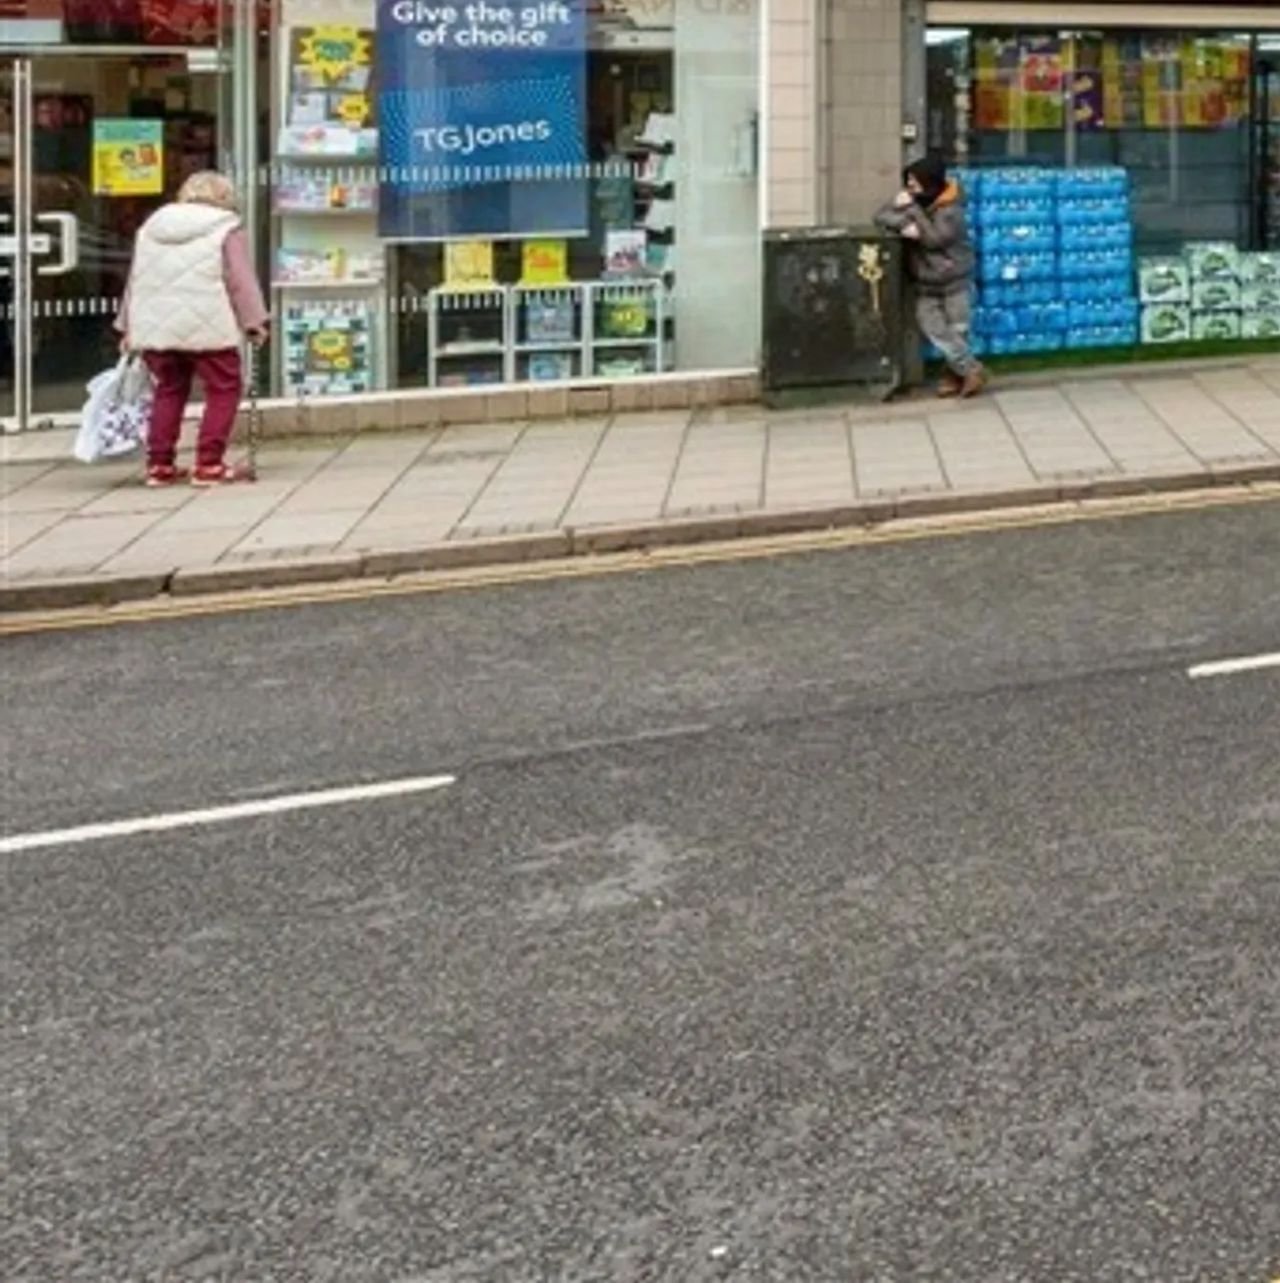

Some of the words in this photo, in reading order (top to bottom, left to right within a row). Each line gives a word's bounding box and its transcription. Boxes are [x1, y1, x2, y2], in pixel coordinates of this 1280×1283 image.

[391, 0, 458, 25] Give
[464, 2, 515, 24] the
[519, 4, 572, 29] gift
[416, 23, 449, 47] of
[453, 24, 549, 48] choice
[415, 119, 552, 154] TGJones
